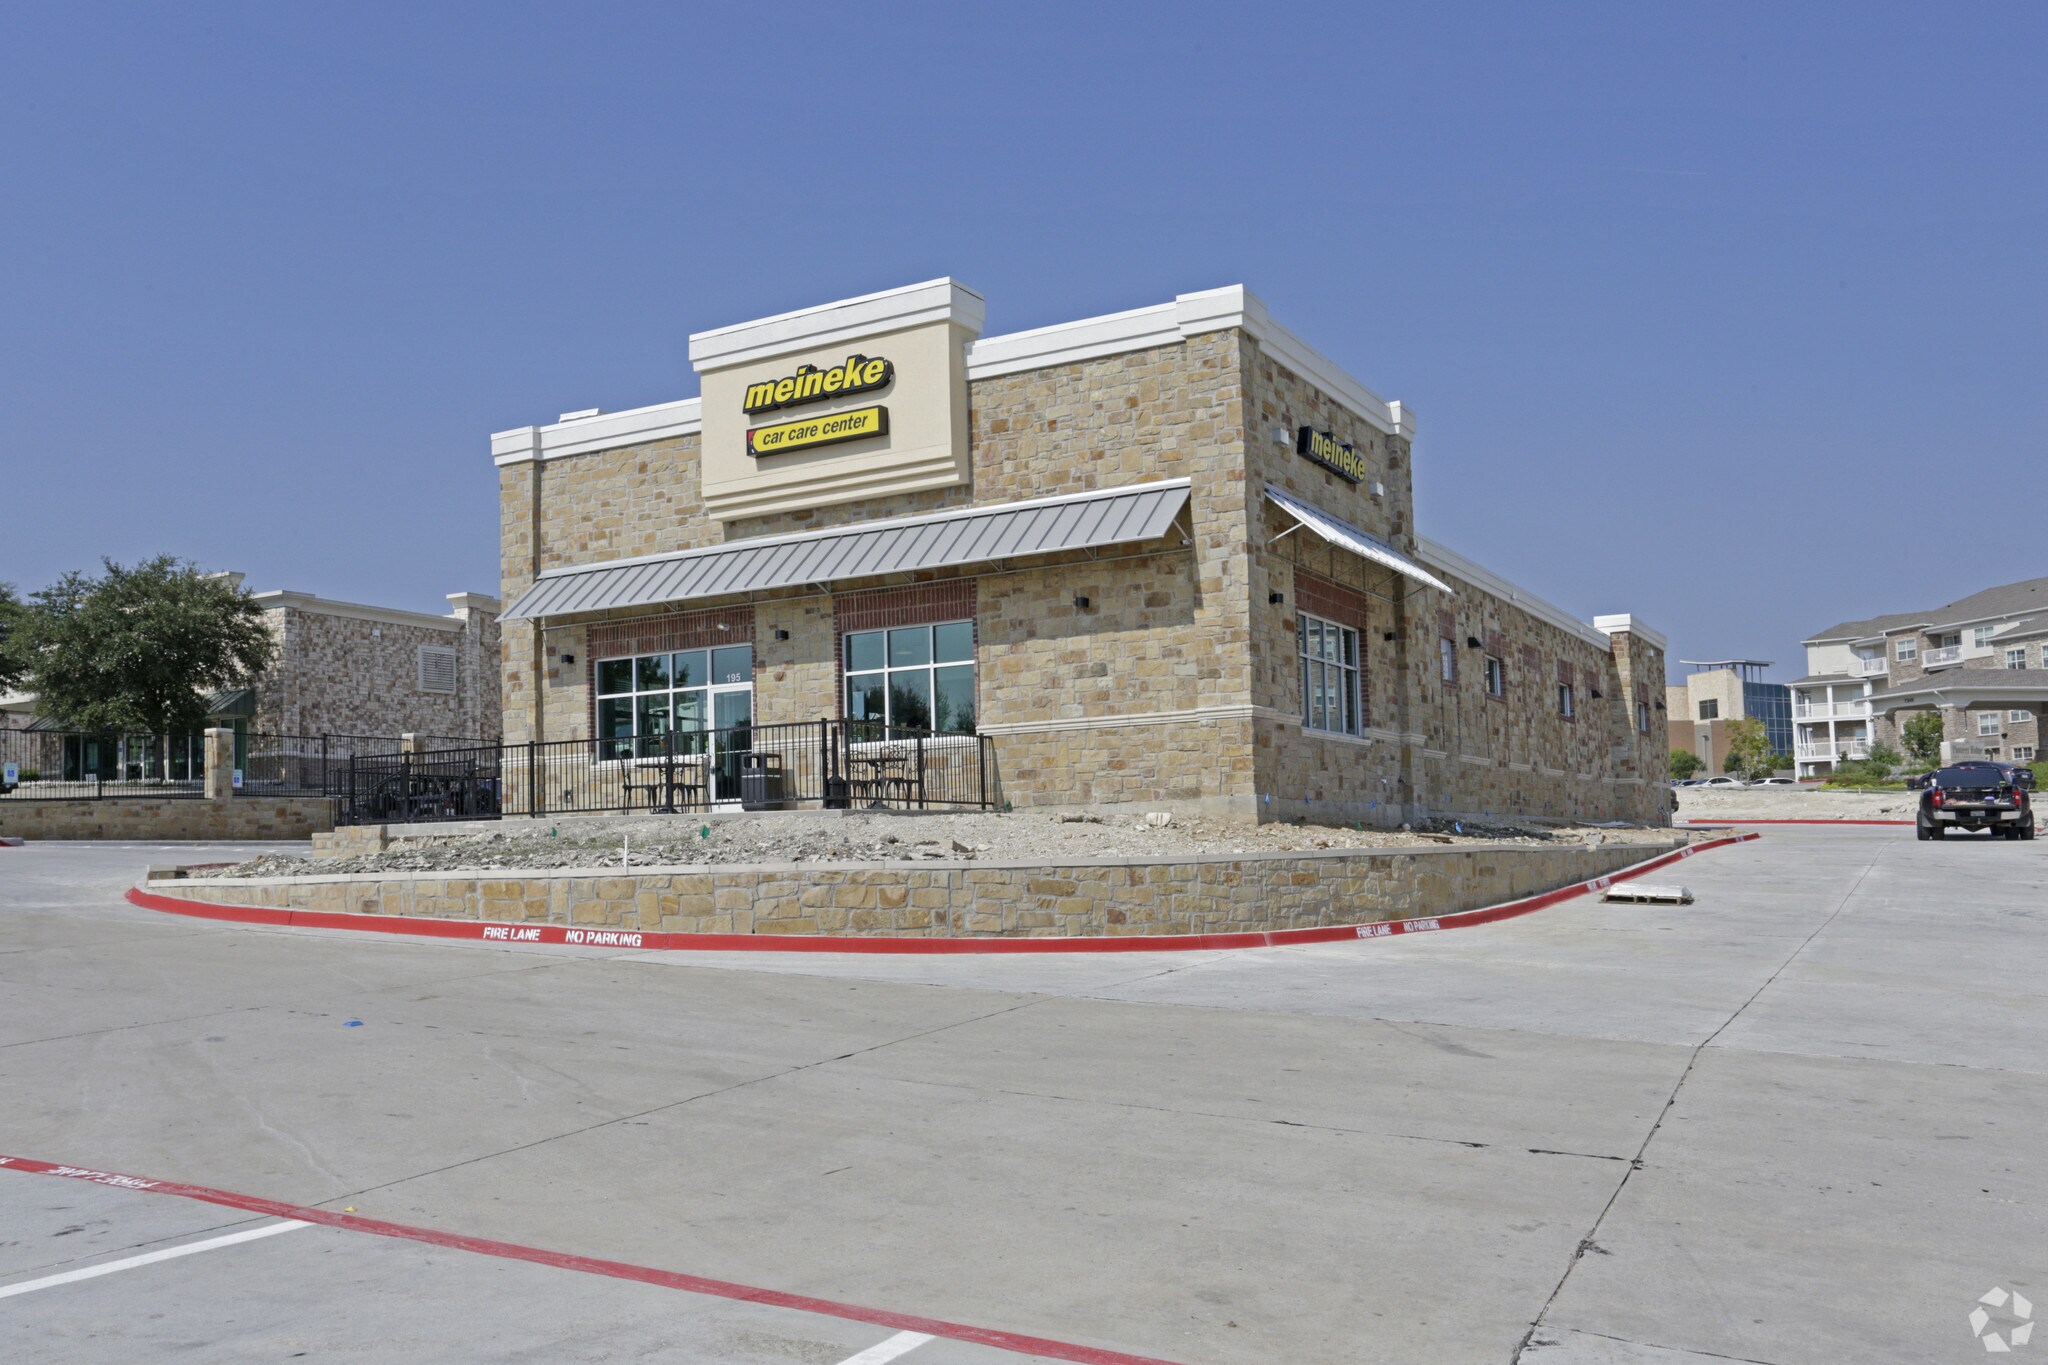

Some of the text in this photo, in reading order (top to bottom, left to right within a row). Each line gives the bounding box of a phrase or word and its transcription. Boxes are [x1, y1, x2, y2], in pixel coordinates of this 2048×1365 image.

[744, 357, 886, 409] meineke
[763, 414, 868, 446] car care center
[1310, 430, 1367, 480] meineke
[726, 673, 741, 683] 195
[483, 927, 643, 947] FIRE LANE NO PARKING
[1355, 919, 1440, 938] FIRE LANE NO PARKING
